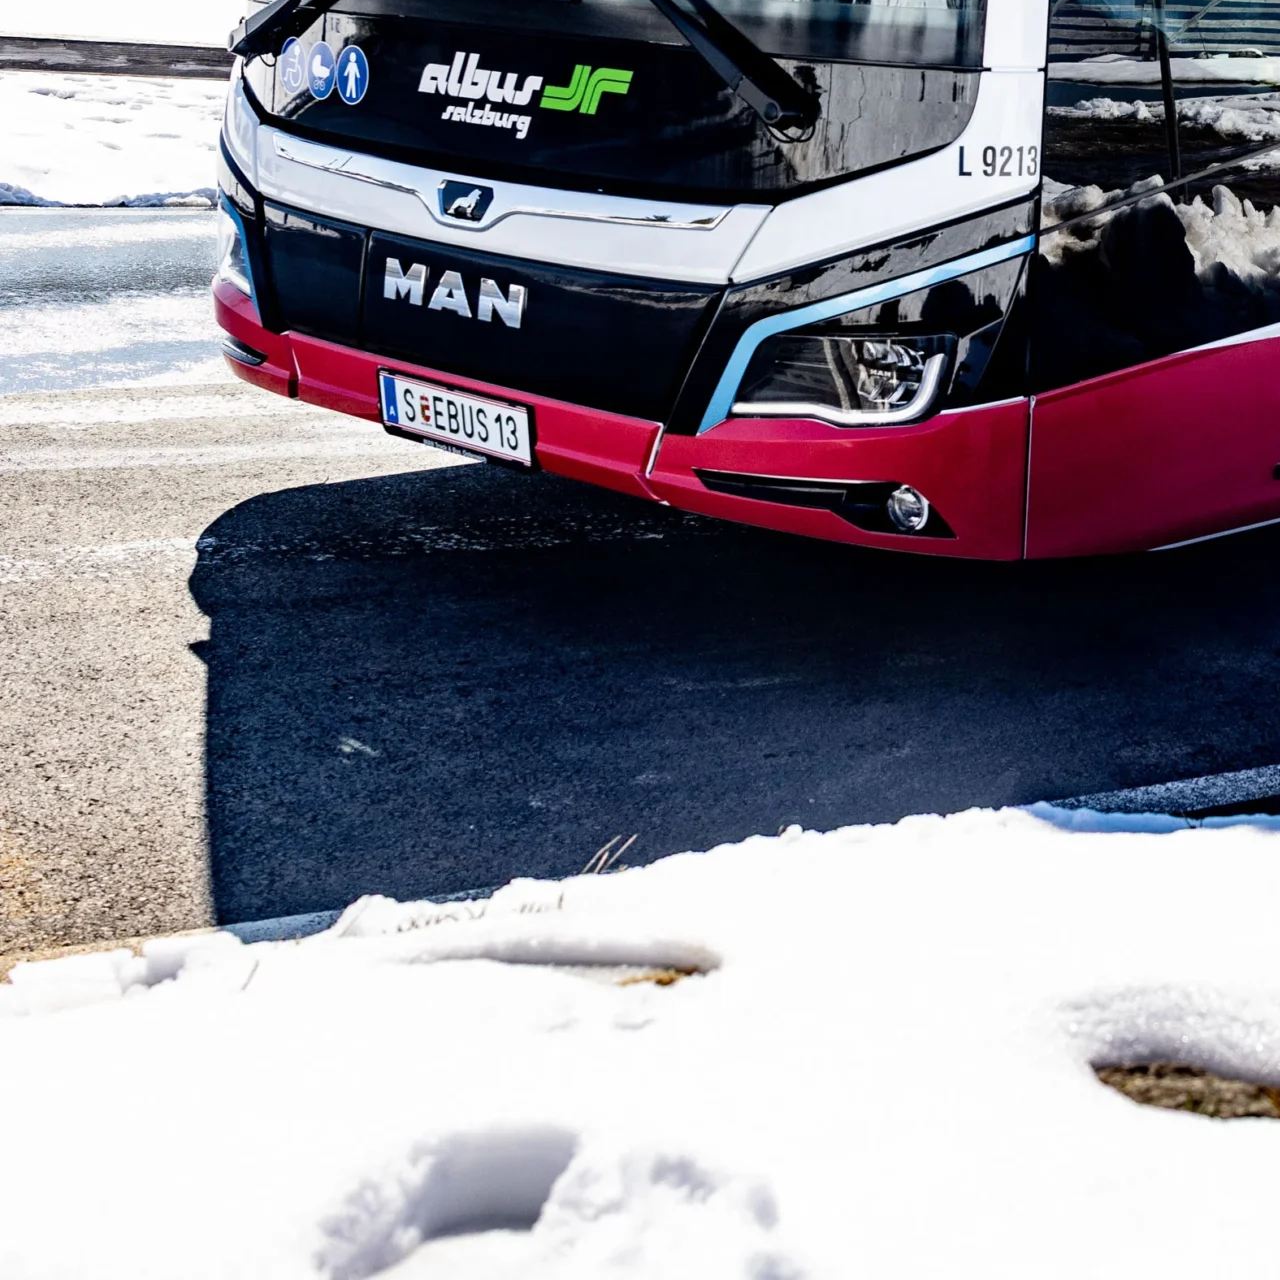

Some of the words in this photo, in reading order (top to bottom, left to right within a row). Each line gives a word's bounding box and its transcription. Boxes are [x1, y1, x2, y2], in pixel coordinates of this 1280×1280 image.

[417, 51, 544, 106] albus
[441, 102, 532, 139] salzburg
[958, 146, 972, 176] L
[982, 145, 1038, 177] 9213
[383, 257, 529, 329] MAN
[389, 405, 396, 416] A
